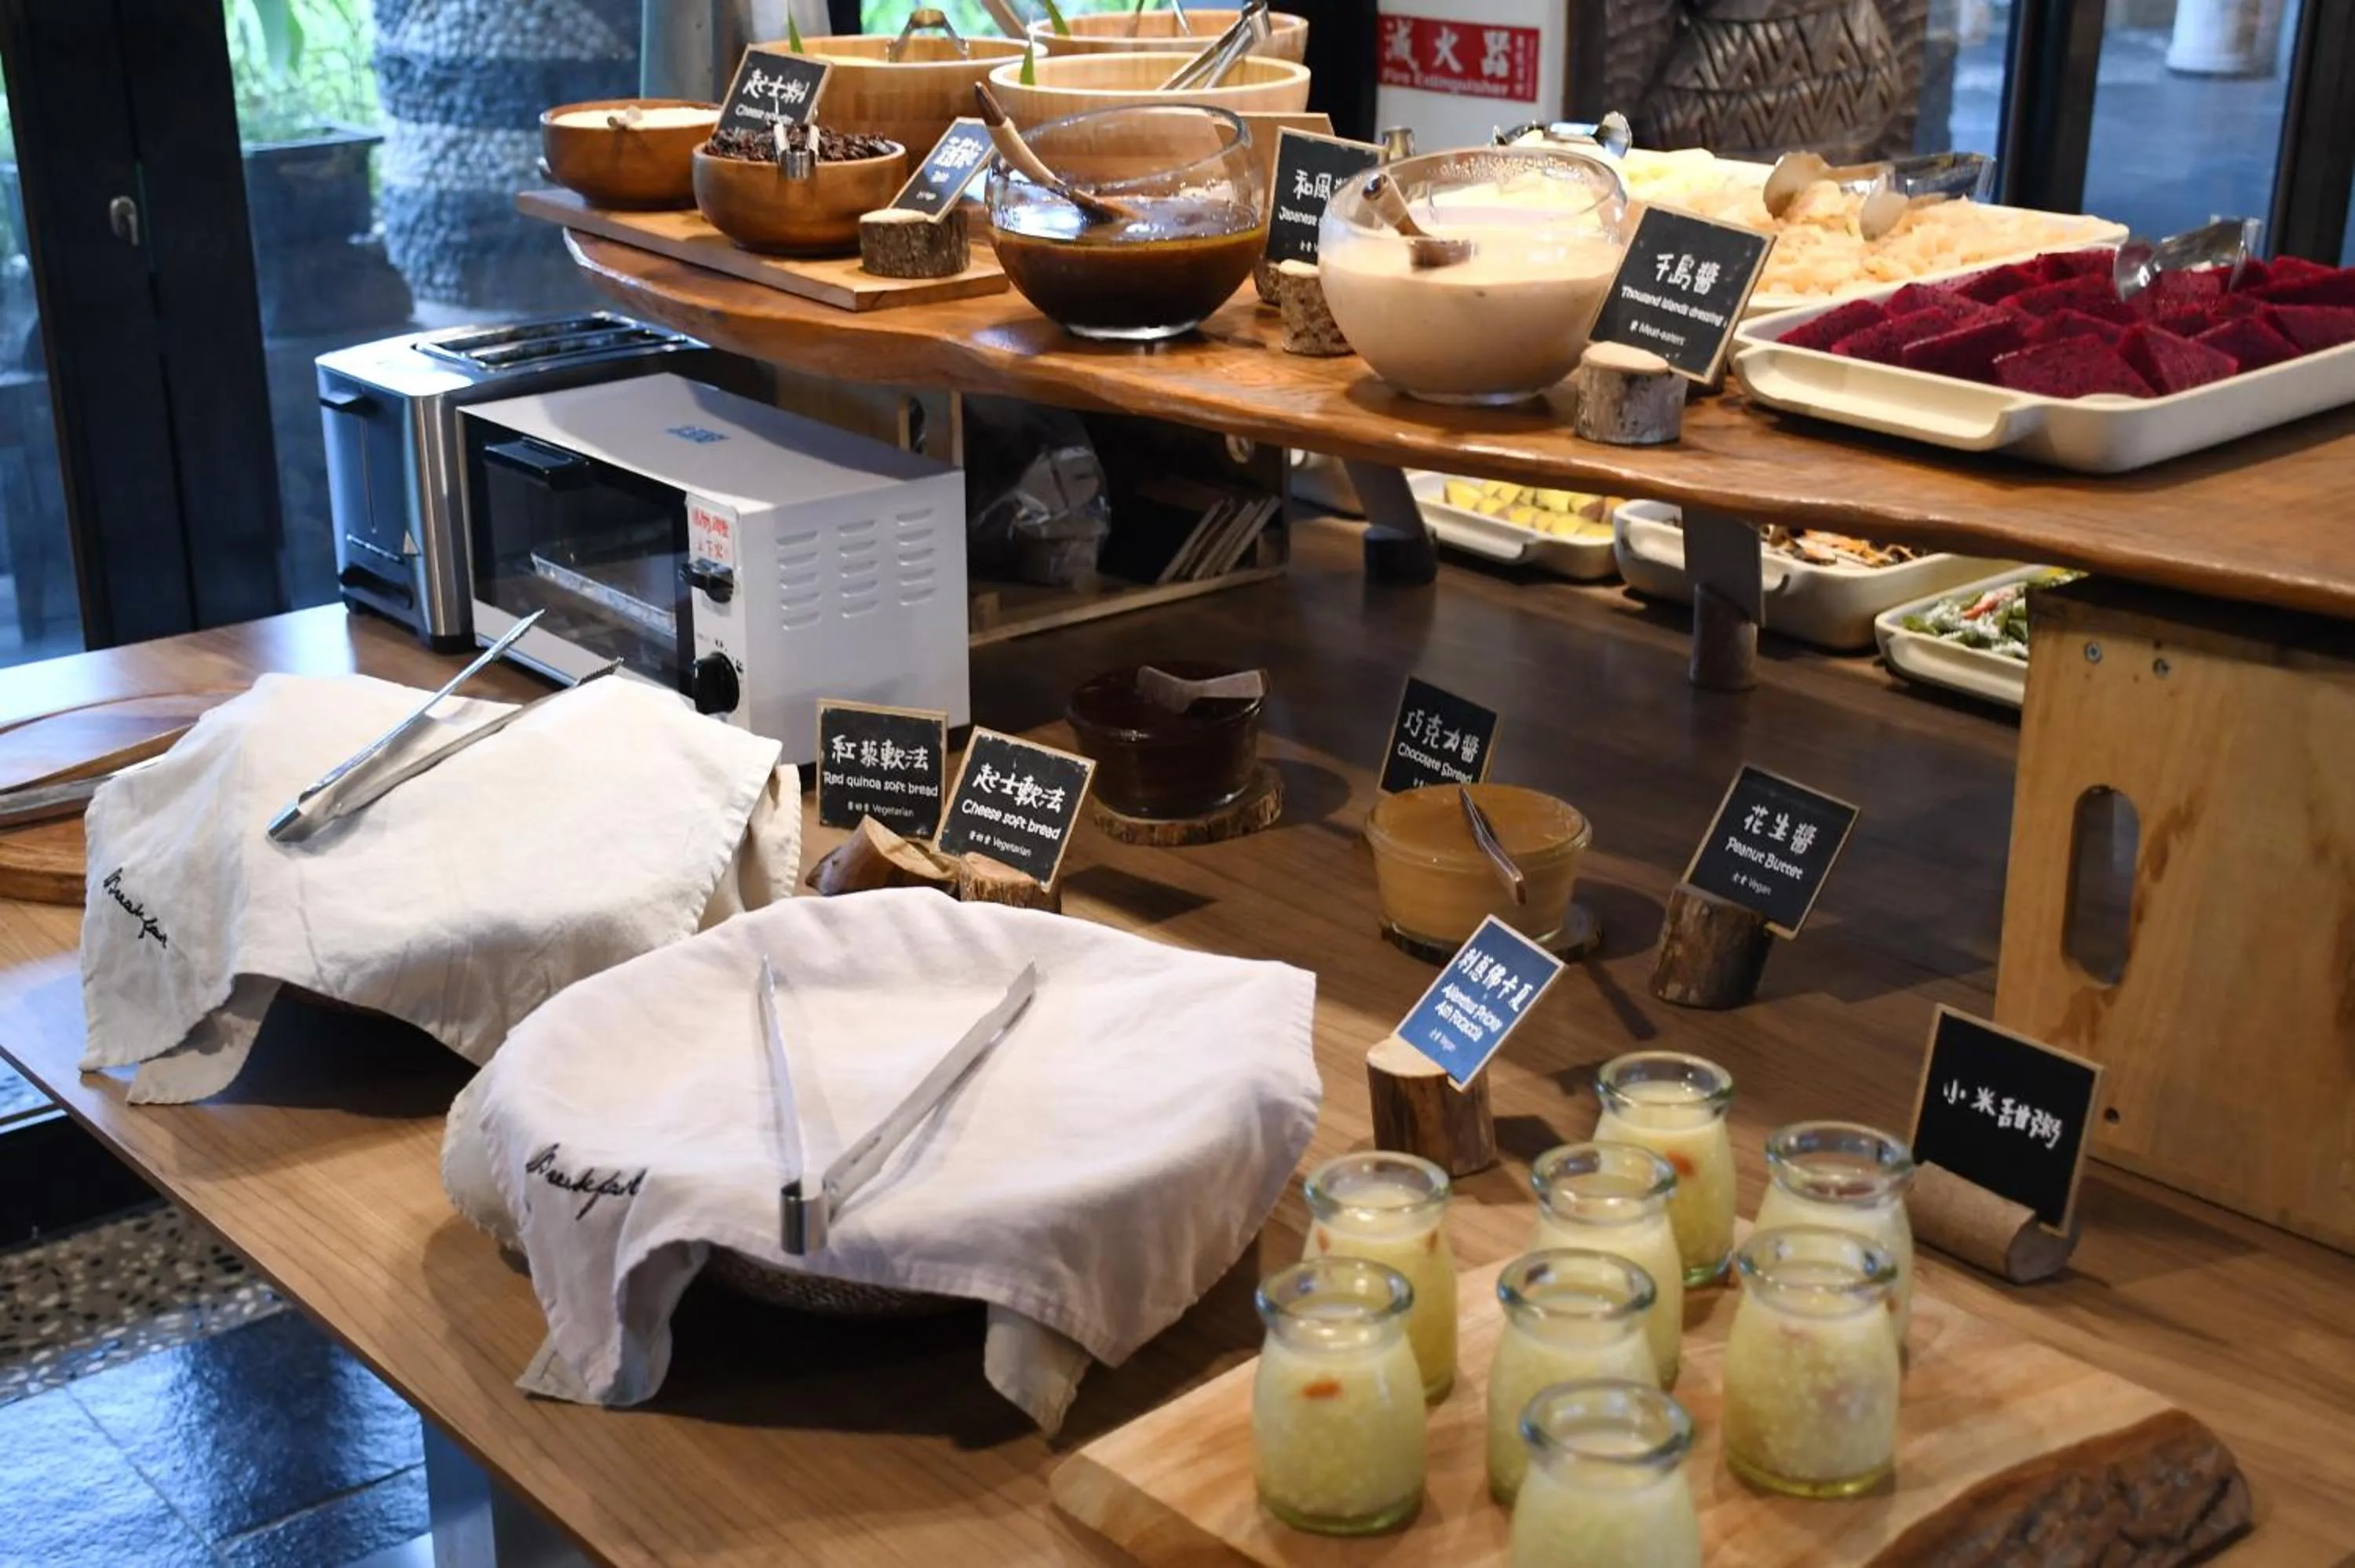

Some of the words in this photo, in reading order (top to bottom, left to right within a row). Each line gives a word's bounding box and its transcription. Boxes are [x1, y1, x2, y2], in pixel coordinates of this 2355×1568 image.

[1656, 253, 1721, 295] 千島醬
[823, 771, 845, 786] Red
[846, 775, 882, 791] quinoa
[884, 781, 907, 793] soft
[909, 783, 939, 797] bread
[962, 798, 1002, 822] Cheese
[1002, 812, 1027, 830] soft
[1027, 819, 1062, 841] bread
[1743, 804, 1817, 855] 花生醬
[1725, 836, 1766, 864] Peanut
[1943, 1079, 2062, 1150] 小米甜粥
